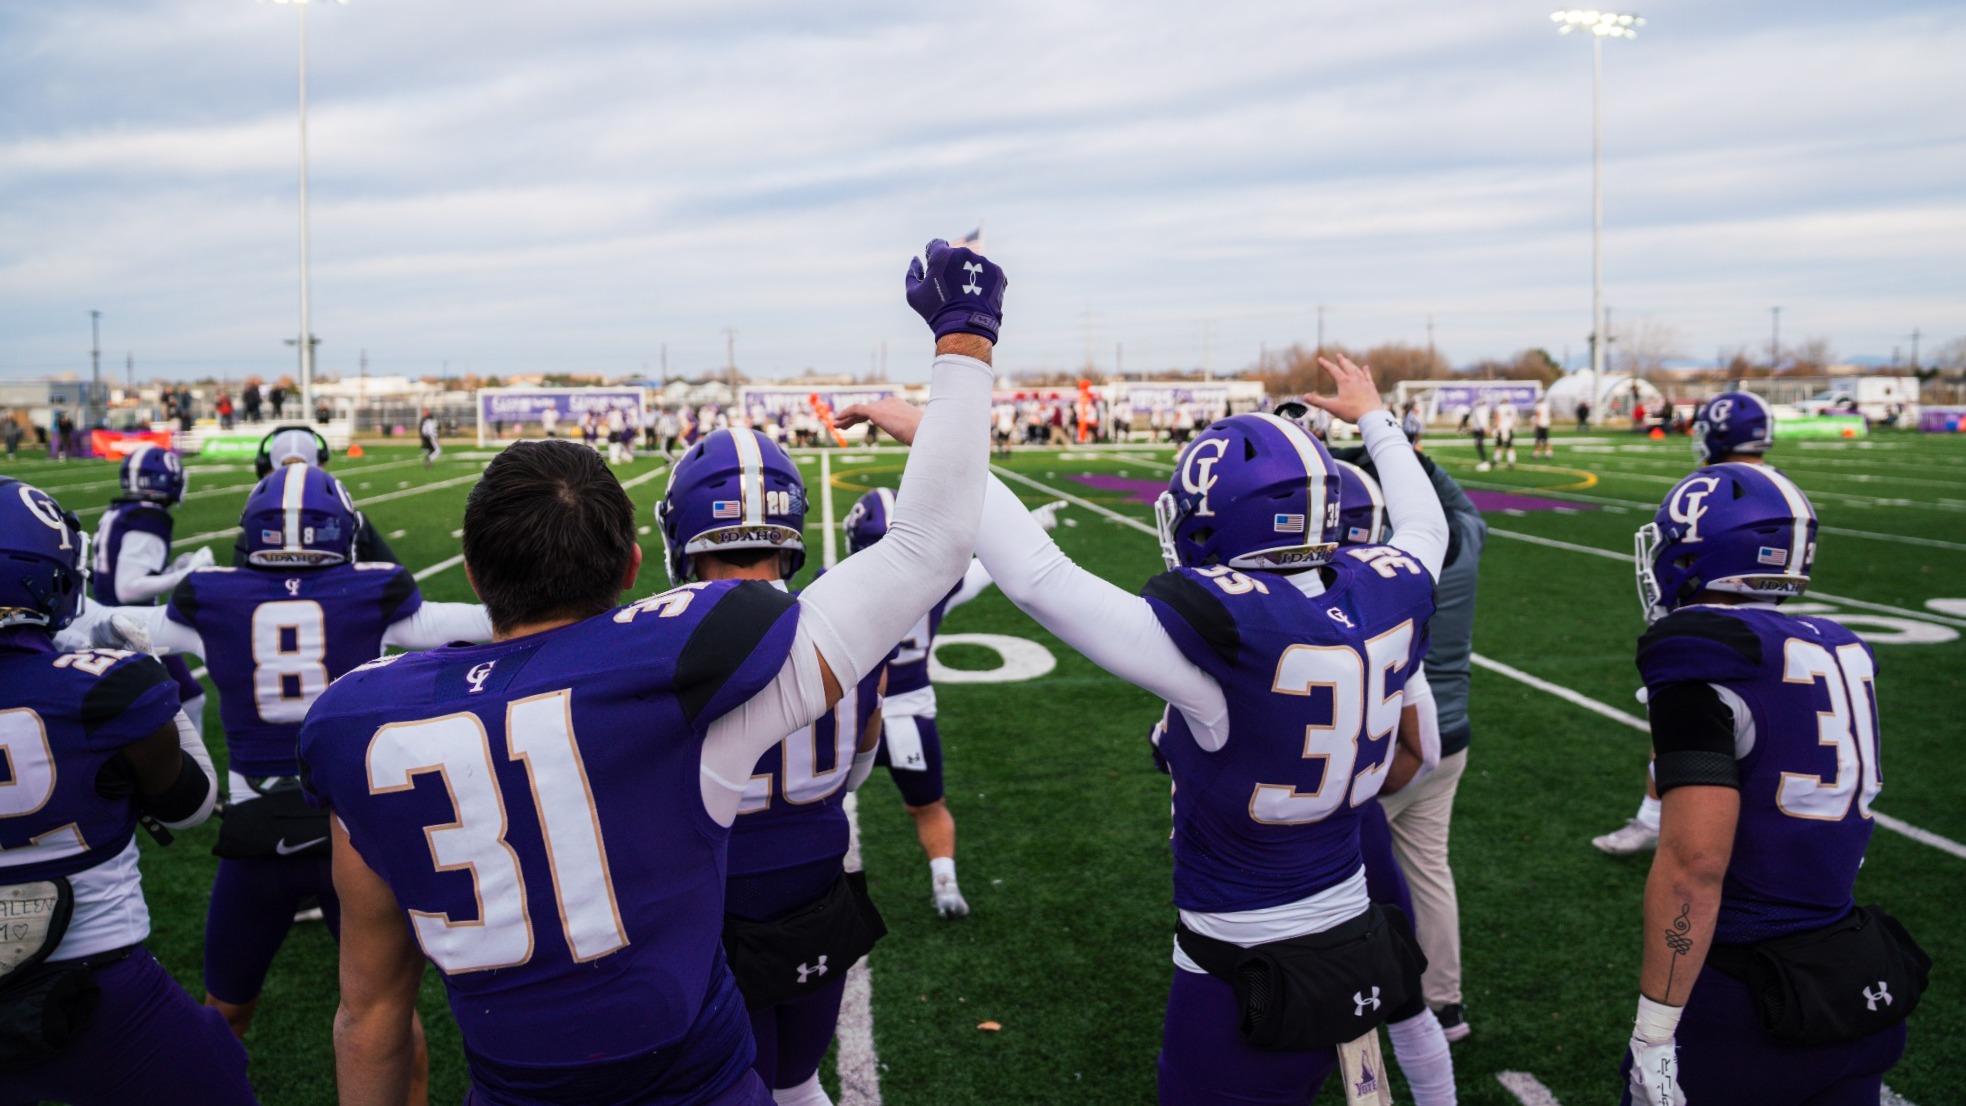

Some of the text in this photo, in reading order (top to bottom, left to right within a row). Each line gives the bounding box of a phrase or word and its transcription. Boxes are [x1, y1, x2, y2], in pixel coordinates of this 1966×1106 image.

[767, 490, 789, 515] 20
[304, 527, 314, 545] 8
[719, 529, 782, 544] IDAHO
[252, 600, 330, 724] 8
[1248, 618, 1413, 826] 35
[366, 688, 630, 975] 31
[1354, 1080, 1377, 1097] YOTE
